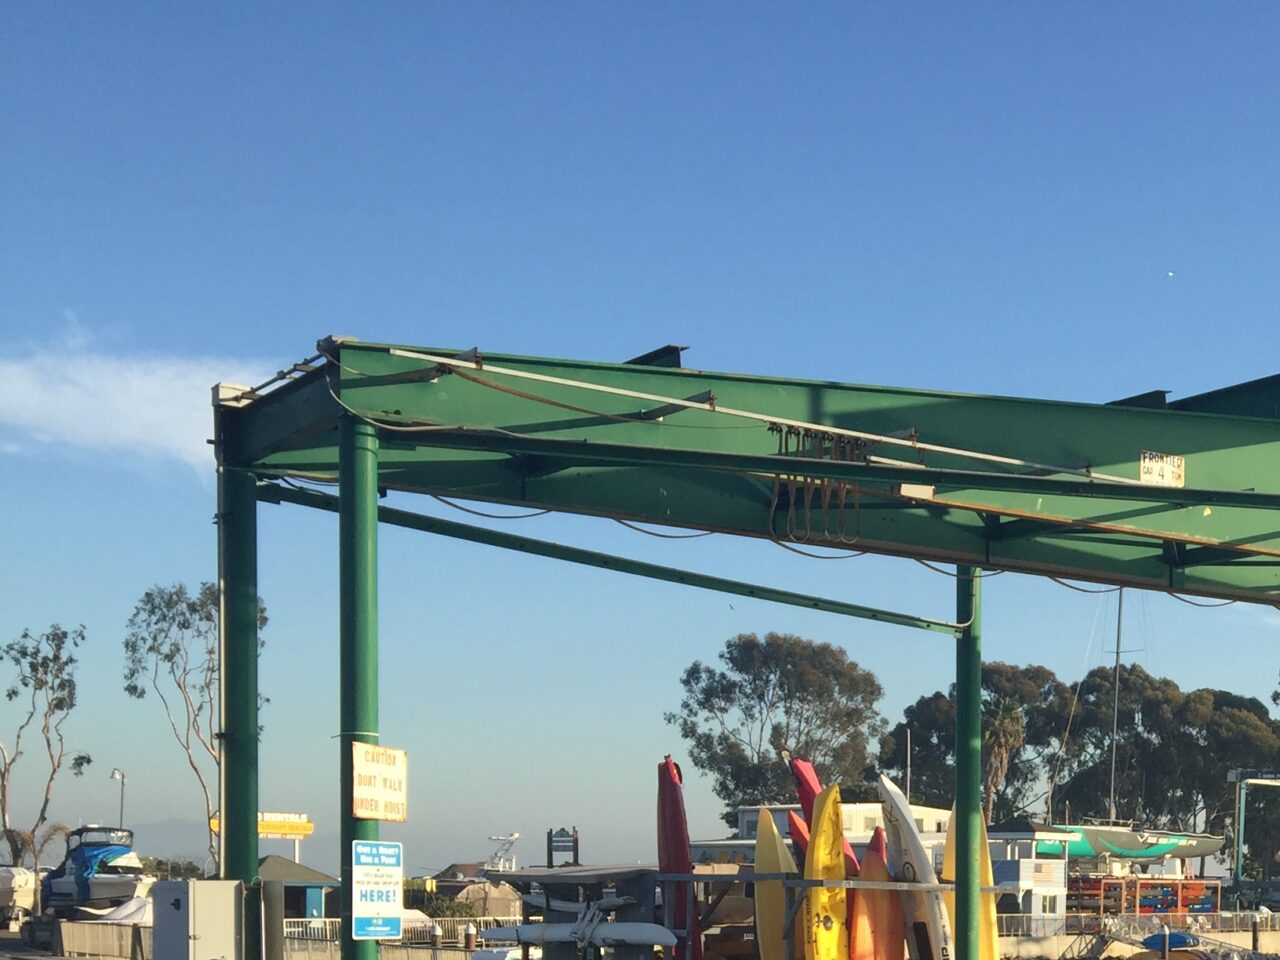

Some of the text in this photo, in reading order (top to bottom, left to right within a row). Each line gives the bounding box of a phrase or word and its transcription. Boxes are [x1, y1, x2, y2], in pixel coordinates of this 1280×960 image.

[1142, 451, 1183, 468] FRONTIER
[1158, 466, 1165, 480] 4
[364, 749, 396, 766] CAUTION
[382, 777, 402, 791] WALK
[354, 796, 405, 815] UNDER HOIST
[360, 889, 396, 902] HERE!
